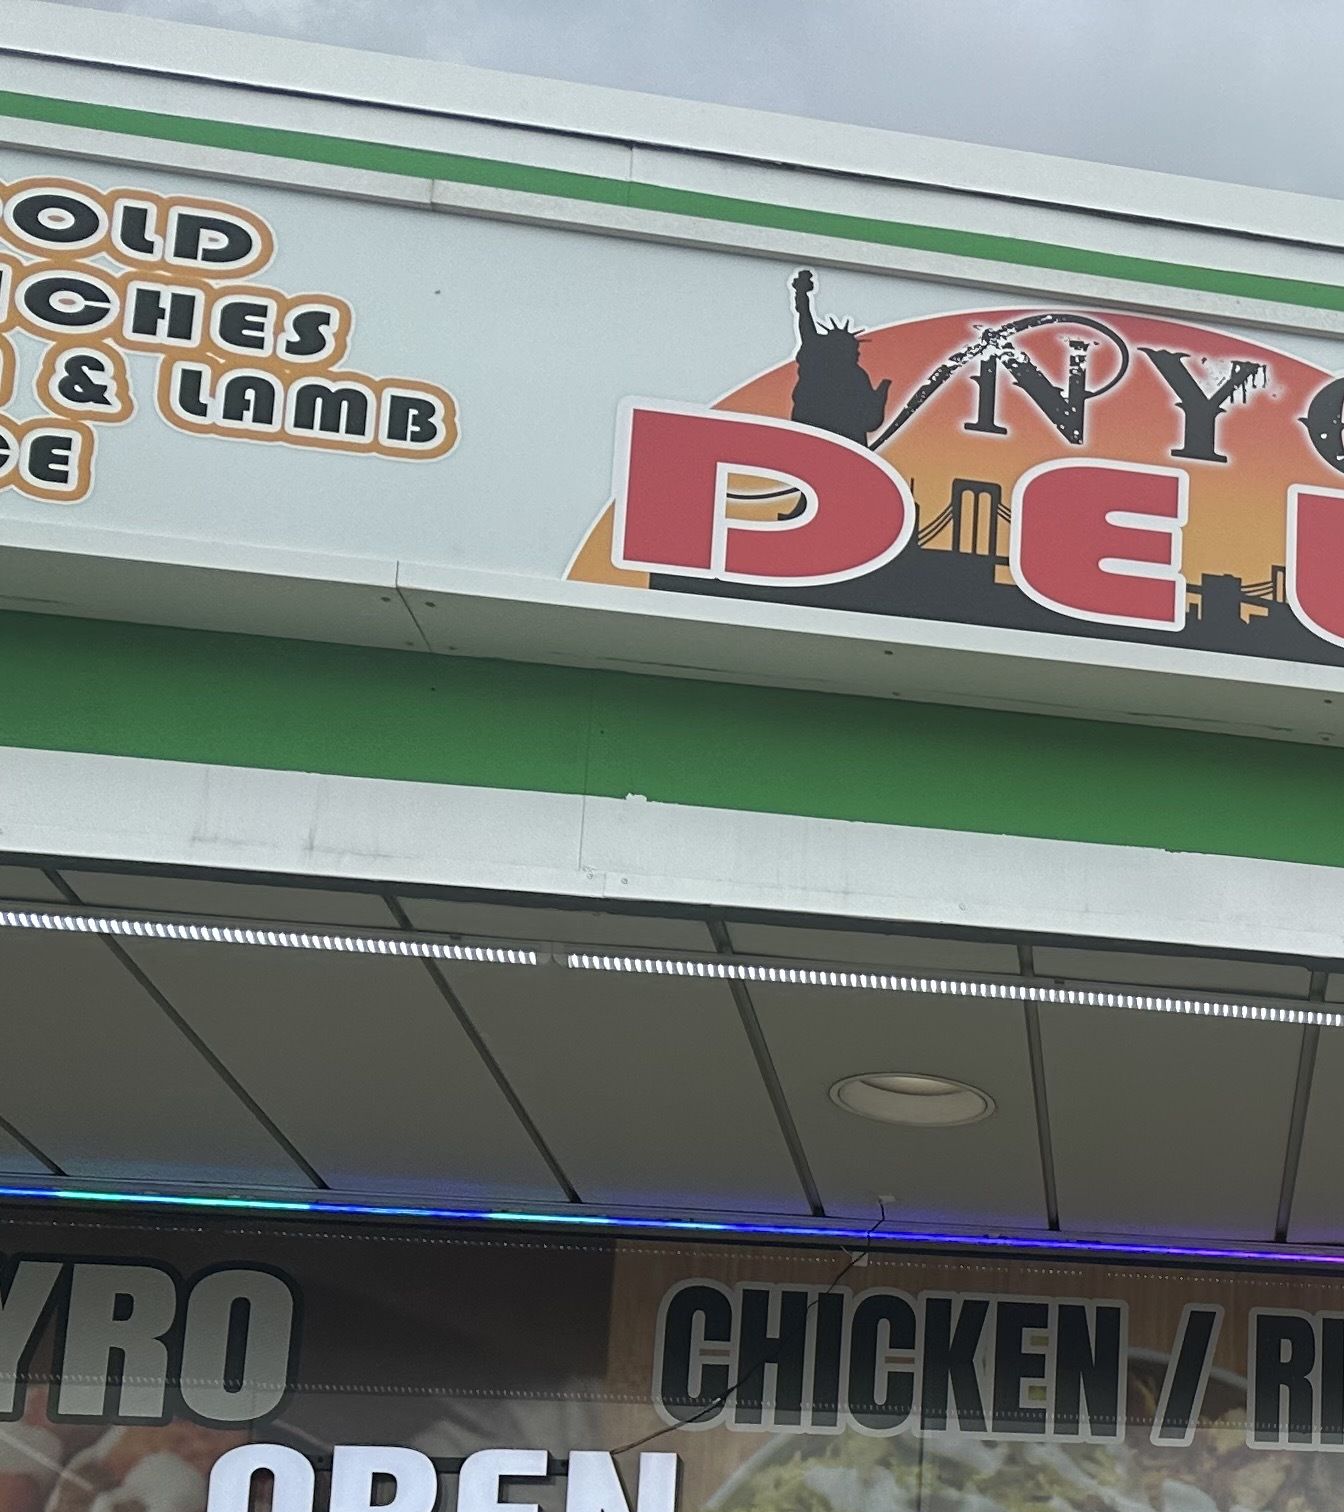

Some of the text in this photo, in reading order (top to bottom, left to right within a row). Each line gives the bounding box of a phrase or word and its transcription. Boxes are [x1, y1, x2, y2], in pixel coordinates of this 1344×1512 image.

[0, 268, 332, 357] CHES
[58, 354, 438, 443] & LAMB
[662, 1284, 1122, 1437] CHICKEN
